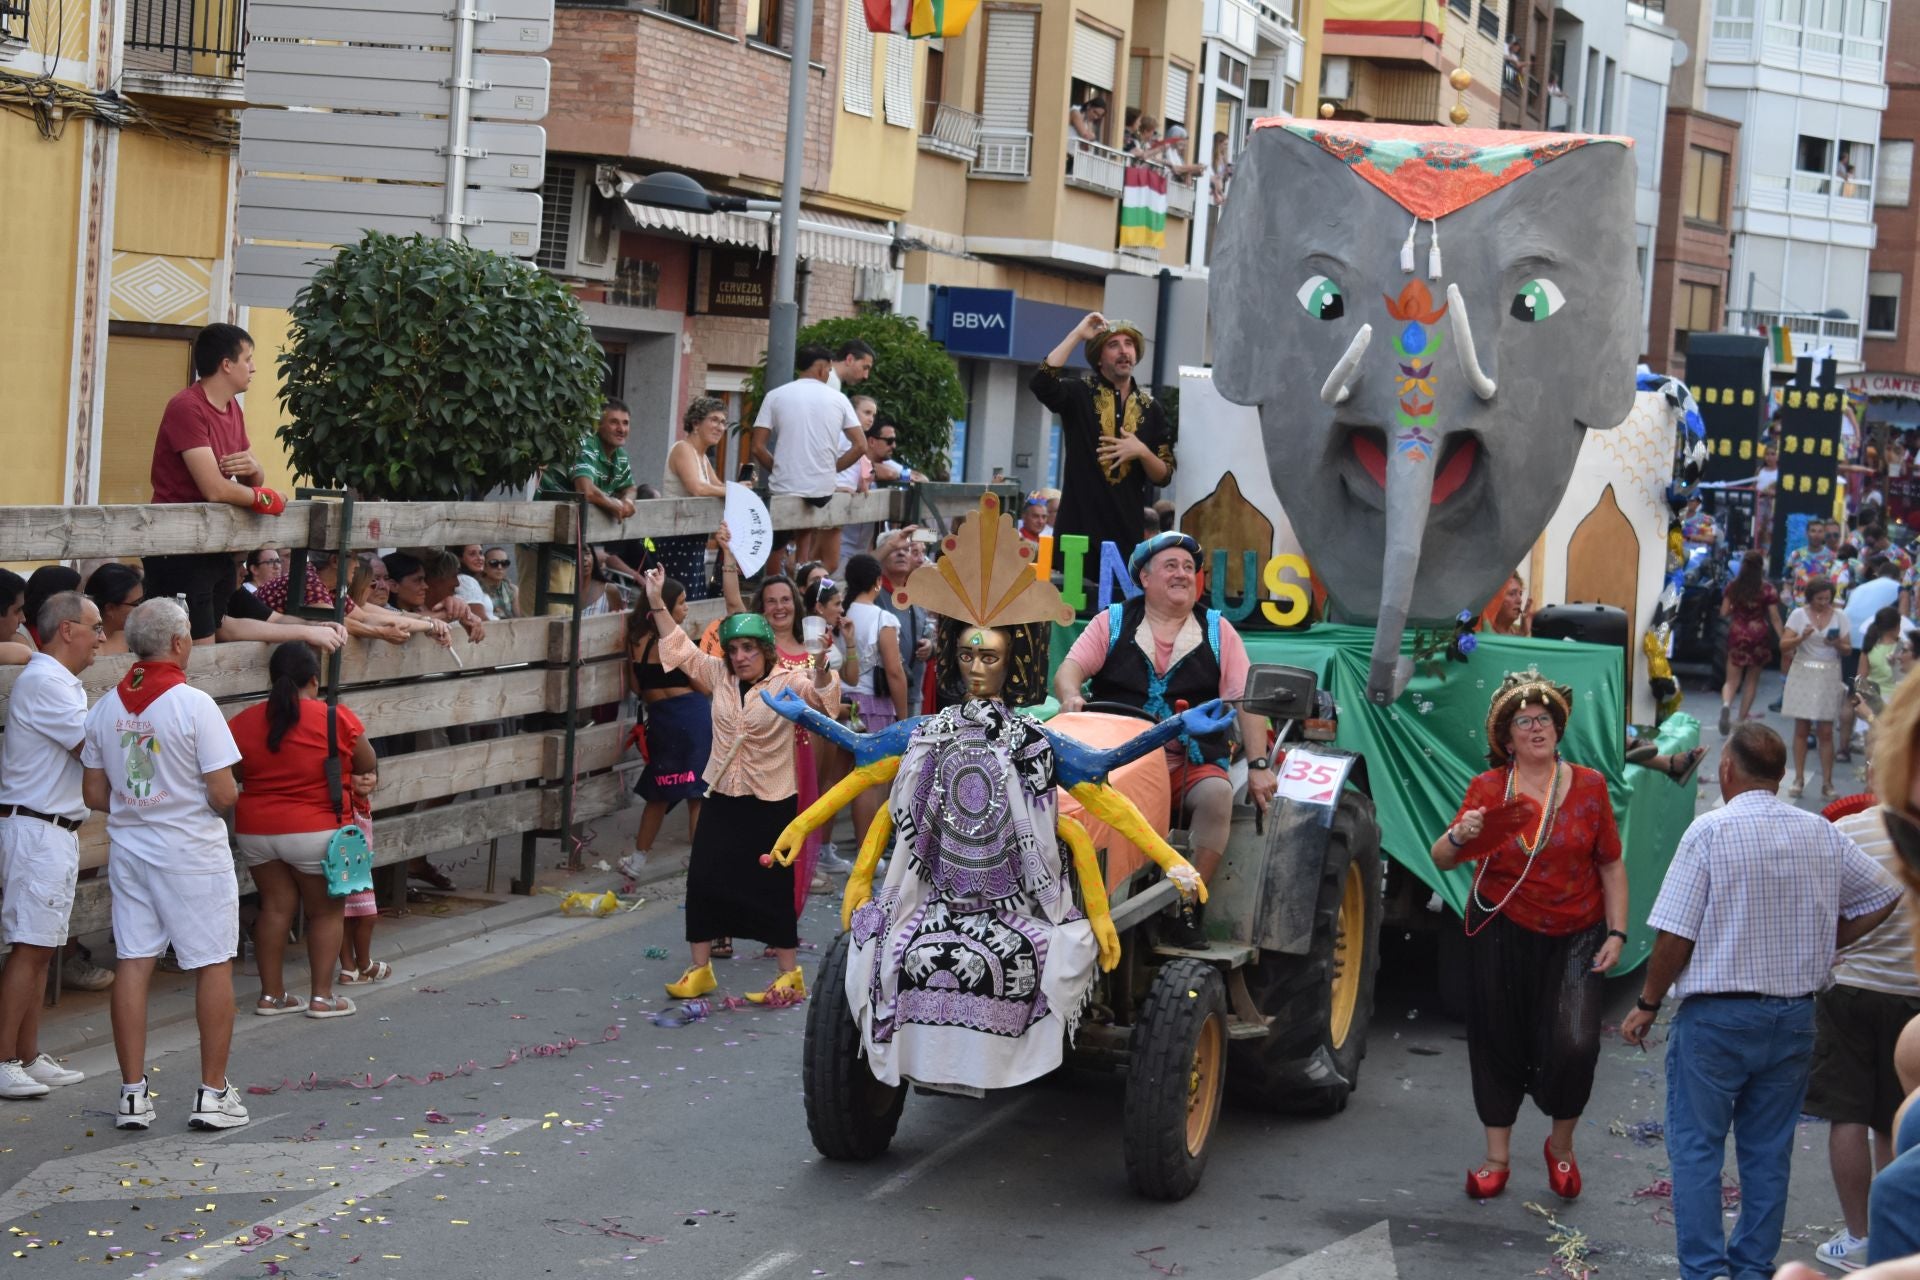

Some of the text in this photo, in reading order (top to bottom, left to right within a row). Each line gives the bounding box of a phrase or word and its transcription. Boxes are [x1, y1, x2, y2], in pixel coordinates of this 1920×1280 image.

[720, 281, 762, 294] CERVEZAS
[715, 293, 763, 307] ALHAMBRA
[952, 311, 1005, 329] BBVA
[1284, 760, 1338, 785] 35
